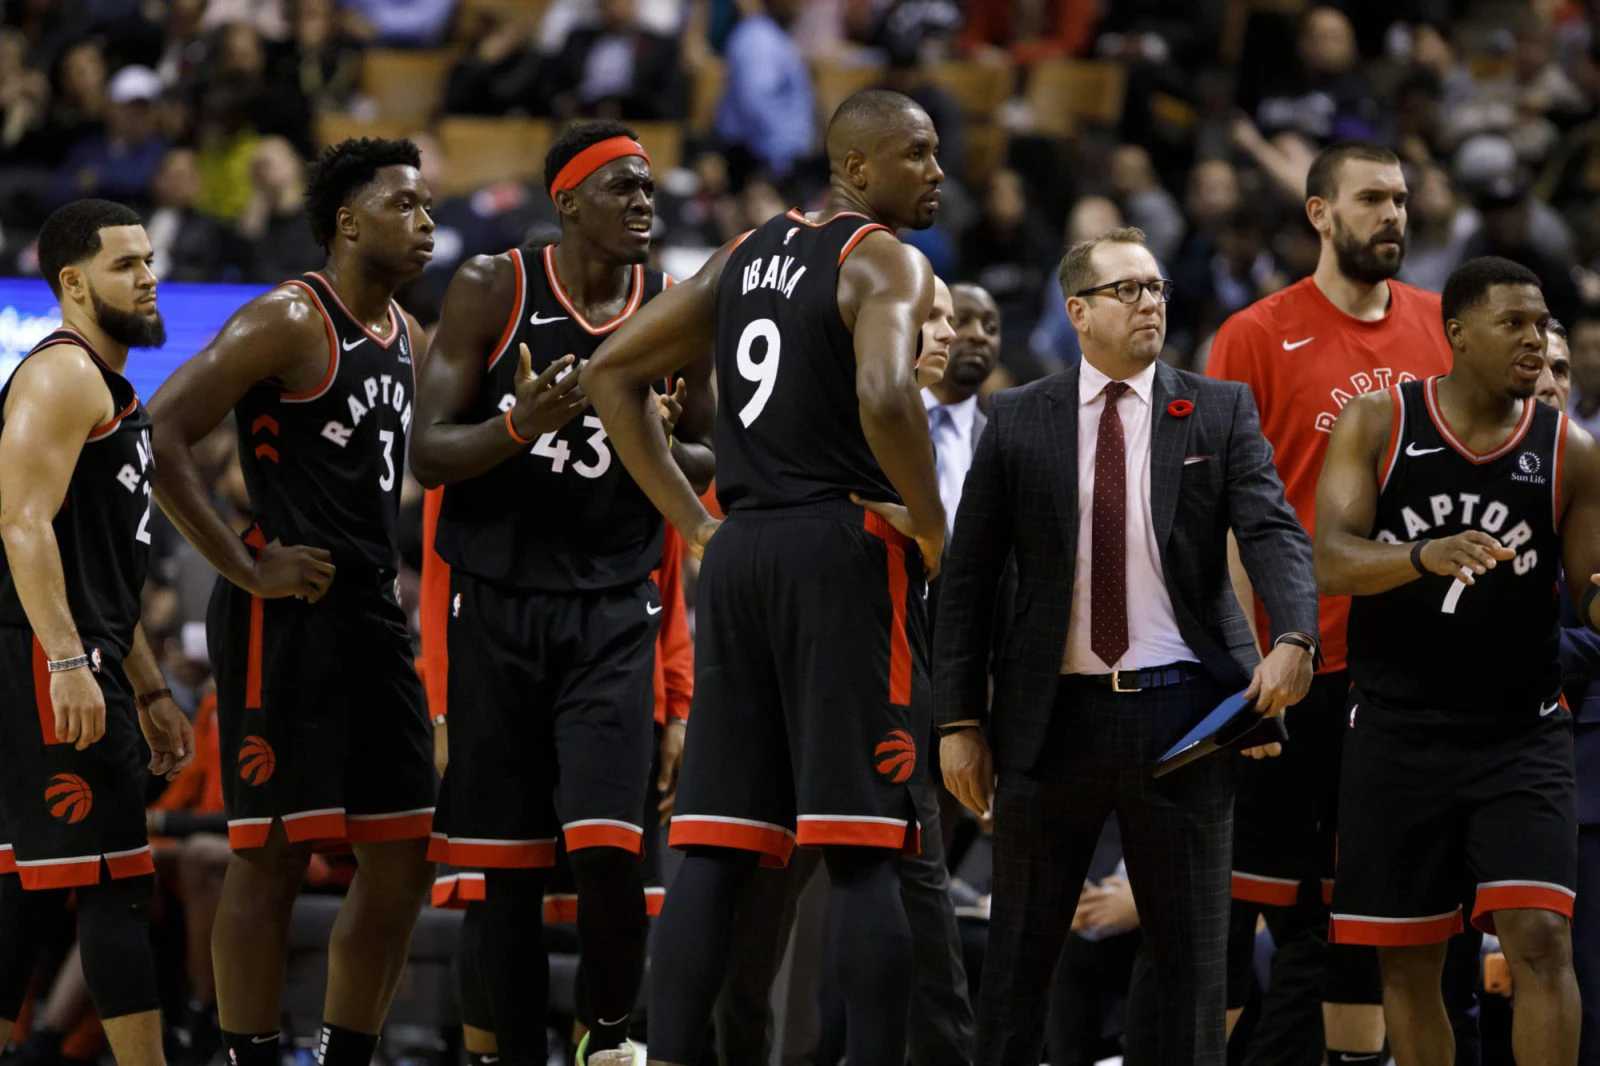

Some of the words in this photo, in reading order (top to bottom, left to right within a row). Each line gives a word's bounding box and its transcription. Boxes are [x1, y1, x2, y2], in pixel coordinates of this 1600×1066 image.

[742, 255, 807, 299] IBAKA
[736, 318, 781, 429] 9
[379, 429, 395, 492] 3
[529, 415, 612, 479] 43
[1510, 472, 1529, 482] Sun
[1529, 474, 1546, 485] Life
